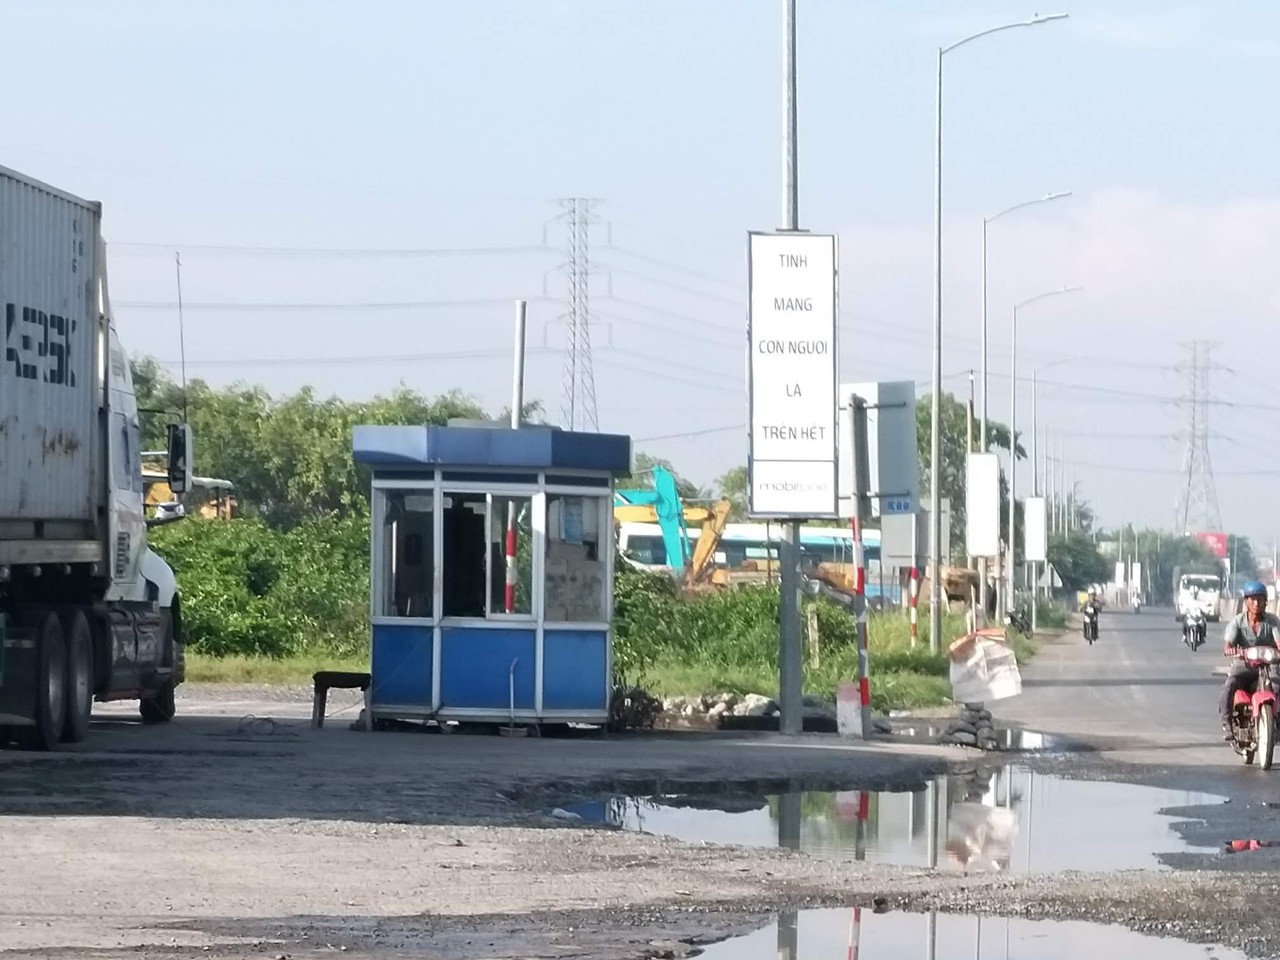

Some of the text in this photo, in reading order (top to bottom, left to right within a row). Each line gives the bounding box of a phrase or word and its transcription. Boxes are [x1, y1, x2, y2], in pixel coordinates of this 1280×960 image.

[774, 297, 813, 312] MANG
[758, 340, 828, 355] CON NGUOI
